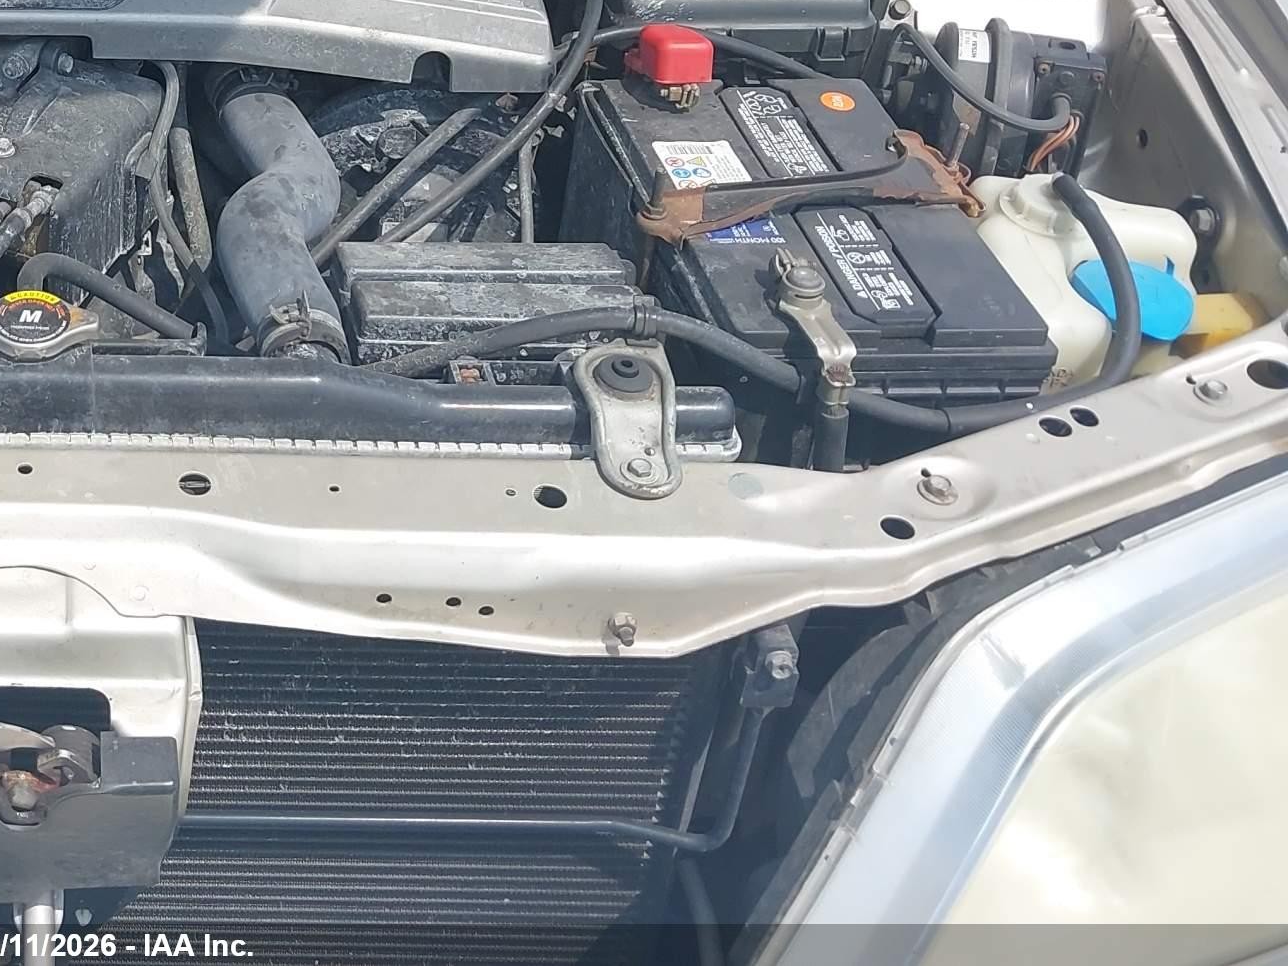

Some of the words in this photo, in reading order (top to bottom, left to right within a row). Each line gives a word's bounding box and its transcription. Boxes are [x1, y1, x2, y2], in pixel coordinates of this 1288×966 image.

[815, 225, 839, 252] POISON
[836, 259, 863, 290] DANGER
[19, 309, 42, 323] M
